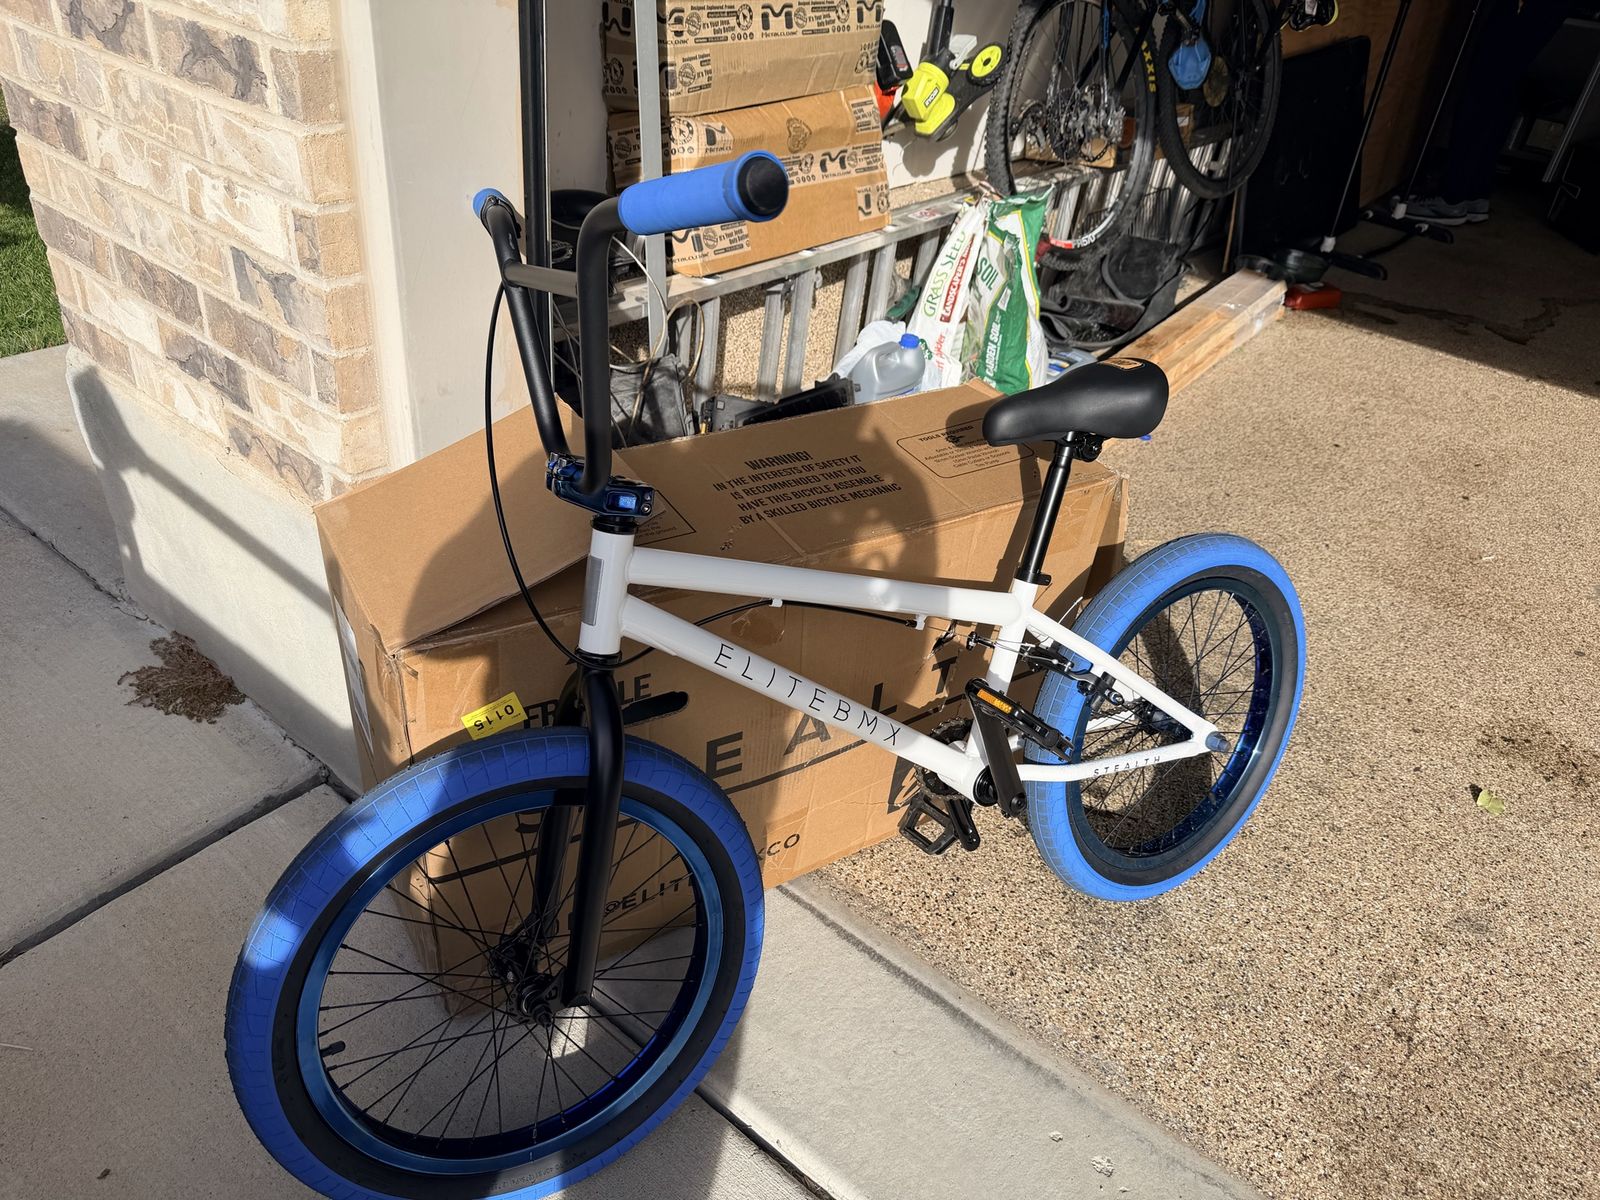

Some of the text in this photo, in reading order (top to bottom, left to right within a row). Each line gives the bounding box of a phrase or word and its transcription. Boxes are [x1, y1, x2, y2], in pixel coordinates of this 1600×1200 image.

[976, 257, 999, 290] SOIL
[923, 270, 949, 317] GRASS
[713, 454, 862, 492] IN THE INTERESTS OF SAFETY IT
[744, 450, 814, 471] WARNING!
[730, 466, 867, 500] IS RECOMMENDED THAT YOU
[738, 474, 885, 511] HAVE THIS BICYCLE ASSEMBLE
[739, 483, 901, 524] BY A SKILLED BICYCLE MECHANIC
[714, 643, 901, 746] ELITEBMX
[1094, 755, 1161, 776] STEALTH
